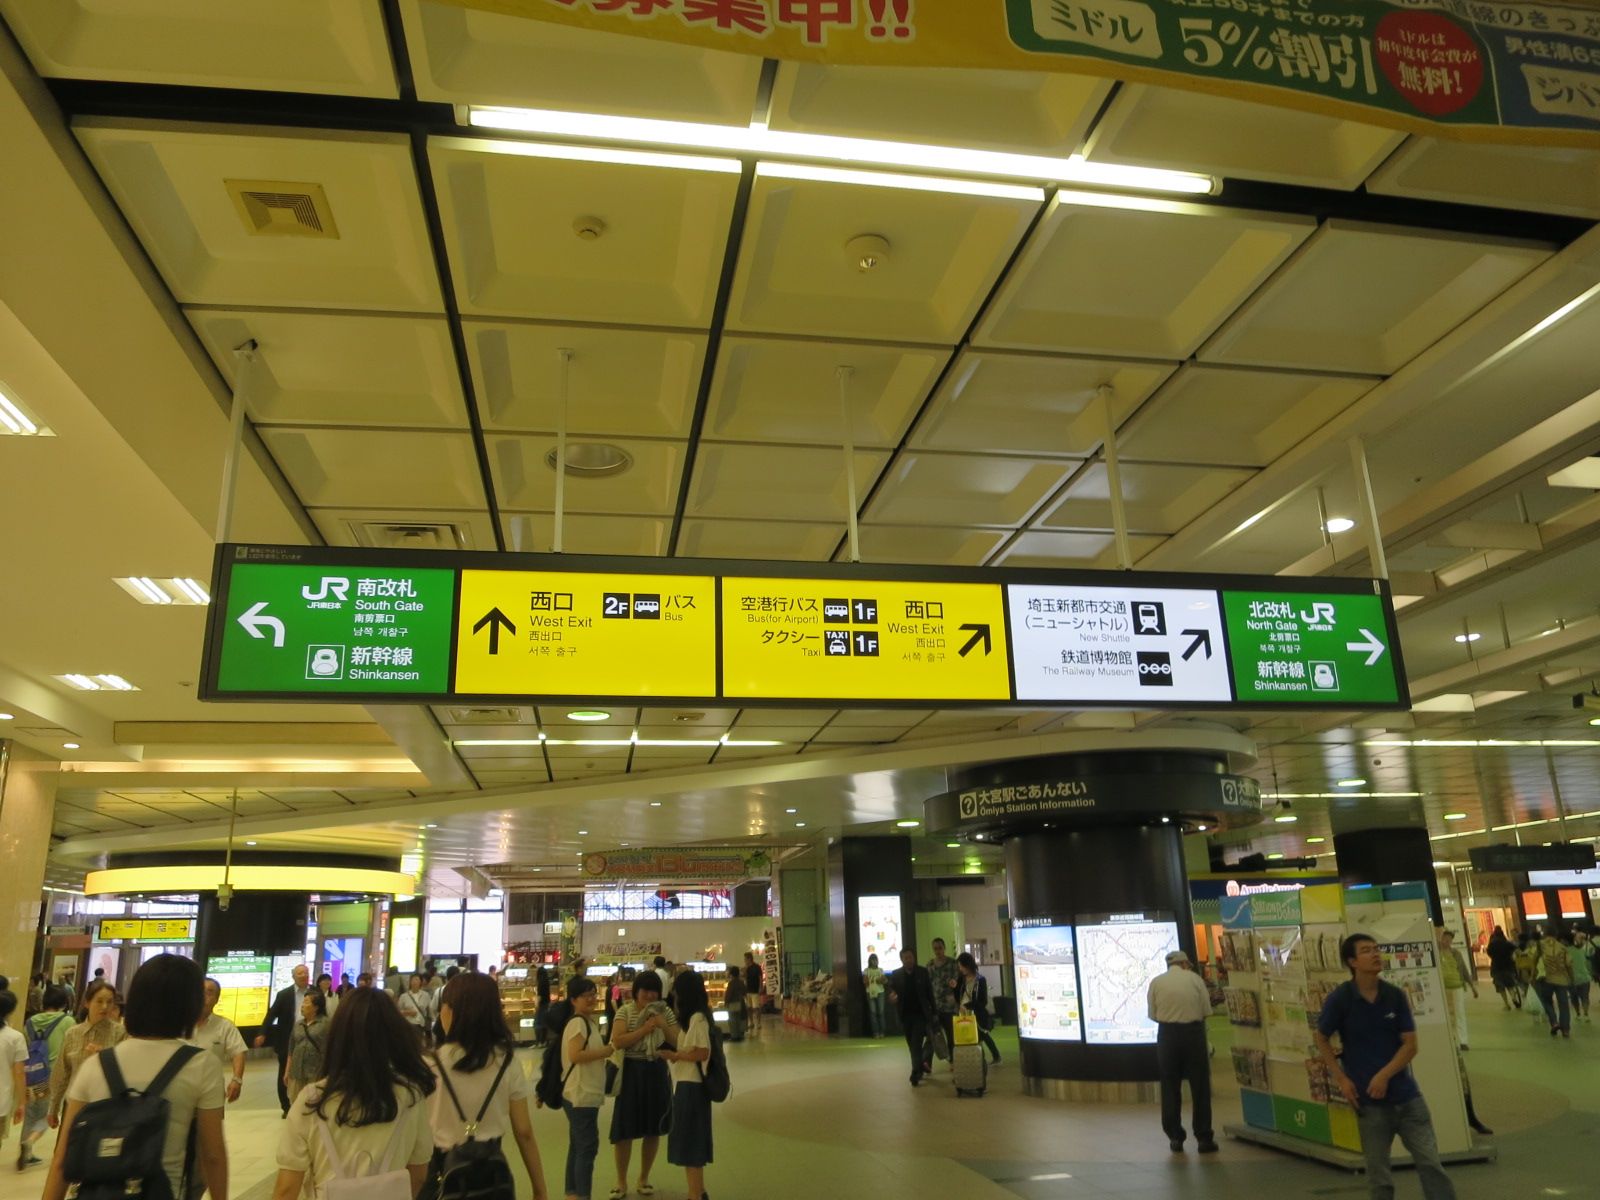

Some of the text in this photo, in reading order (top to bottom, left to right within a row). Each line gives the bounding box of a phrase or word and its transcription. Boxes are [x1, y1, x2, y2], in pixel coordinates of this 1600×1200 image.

[1051, 1, 1144, 43] ミドル
[1179, 18, 1378, 95] 5%割引
[1398, 61, 1464, 96] 無料!
[302, 576, 350, 600] JR
[356, 578, 417, 598] 南改札
[355, 599, 424, 612] South Gate
[530, 591, 573, 611] 西口
[605, 597, 628, 614] 2F
[664, 595, 696, 609] バス
[741, 595, 819, 613] 空港行バス
[1028, 597, 1127, 615] 埼玉新都市交通
[664, 612, 683, 621] Bus
[854, 602, 876, 620] 1F
[904, 600, 944, 620] 西口
[1249, 601, 1296, 619] 北改札
[1300, 602, 1336, 624] JR
[353, 613, 395, 624] 南剪票口
[530, 615, 593, 628] West Exit
[747, 614, 819, 625] Bus(for Airport)
[1246, 620, 1298, 631] North Gate
[353, 627, 373, 637] 남쪽
[529, 630, 562, 642] 西出口
[826, 631, 848, 639] TAXI
[887, 623, 945, 635] West Exit
[761, 630, 819, 645] タクシー
[855, 634, 877, 653] 1F
[916, 638, 946, 649] 西出口
[1079, 633, 1130, 643] New Shuttle
[350, 646, 413, 667] 新幹線
[801, 647, 821, 657] Taxi
[1061, 649, 1133, 665] 鉄道博物館
[349, 668, 419, 680] Shinkansen
[1043, 666, 1134, 678] The Railway Museum
[1257, 660, 1306, 679] 新幹線
[1254, 680, 1308, 691] Shinkansen
[979, 782, 1087, 805] 大宮駅ごあんない
[1006, 802, 1038, 813] Station
[1040, 798, 1095, 809] Information
